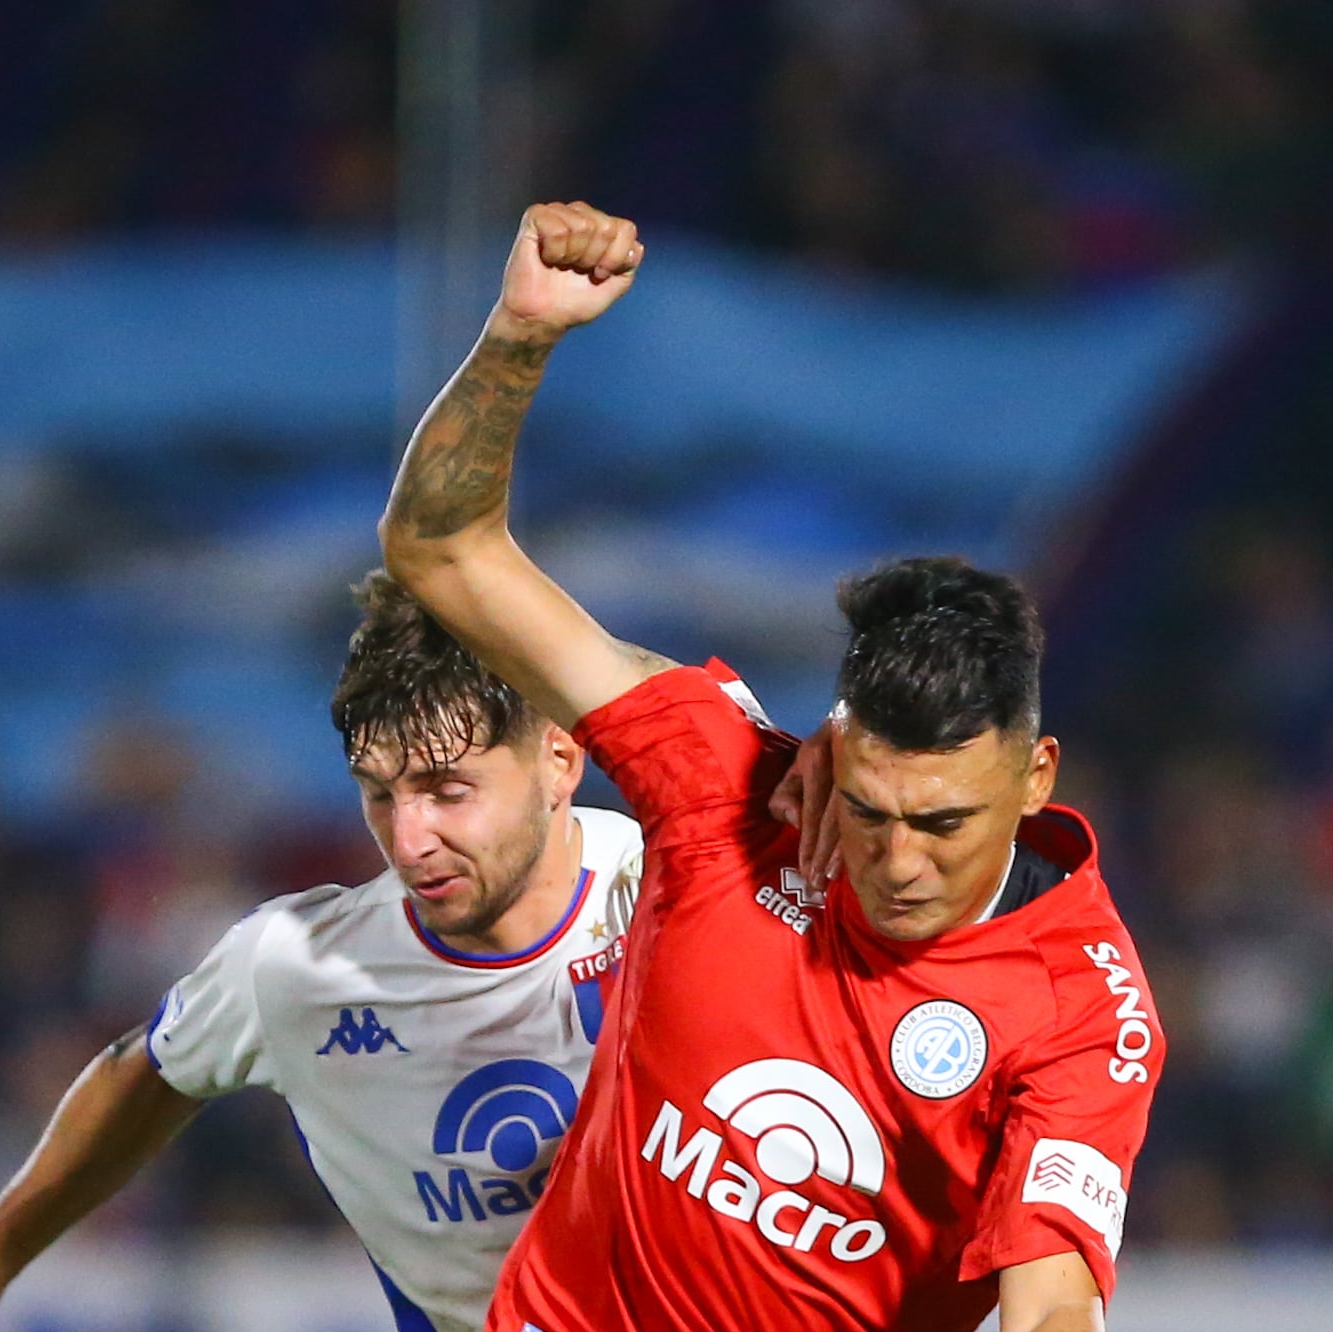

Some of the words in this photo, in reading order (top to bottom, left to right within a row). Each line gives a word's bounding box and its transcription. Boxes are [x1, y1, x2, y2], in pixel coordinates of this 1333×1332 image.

[1082, 942, 1151, 1084] SANOS
[895, 1015, 917, 1044] CLUB
[955, 1028, 982, 1088] BELGRANO
[895, 1060, 940, 1095] CORDOBA
[413, 1168, 551, 1222] Mac
[641, 1099, 887, 1262] Macro
